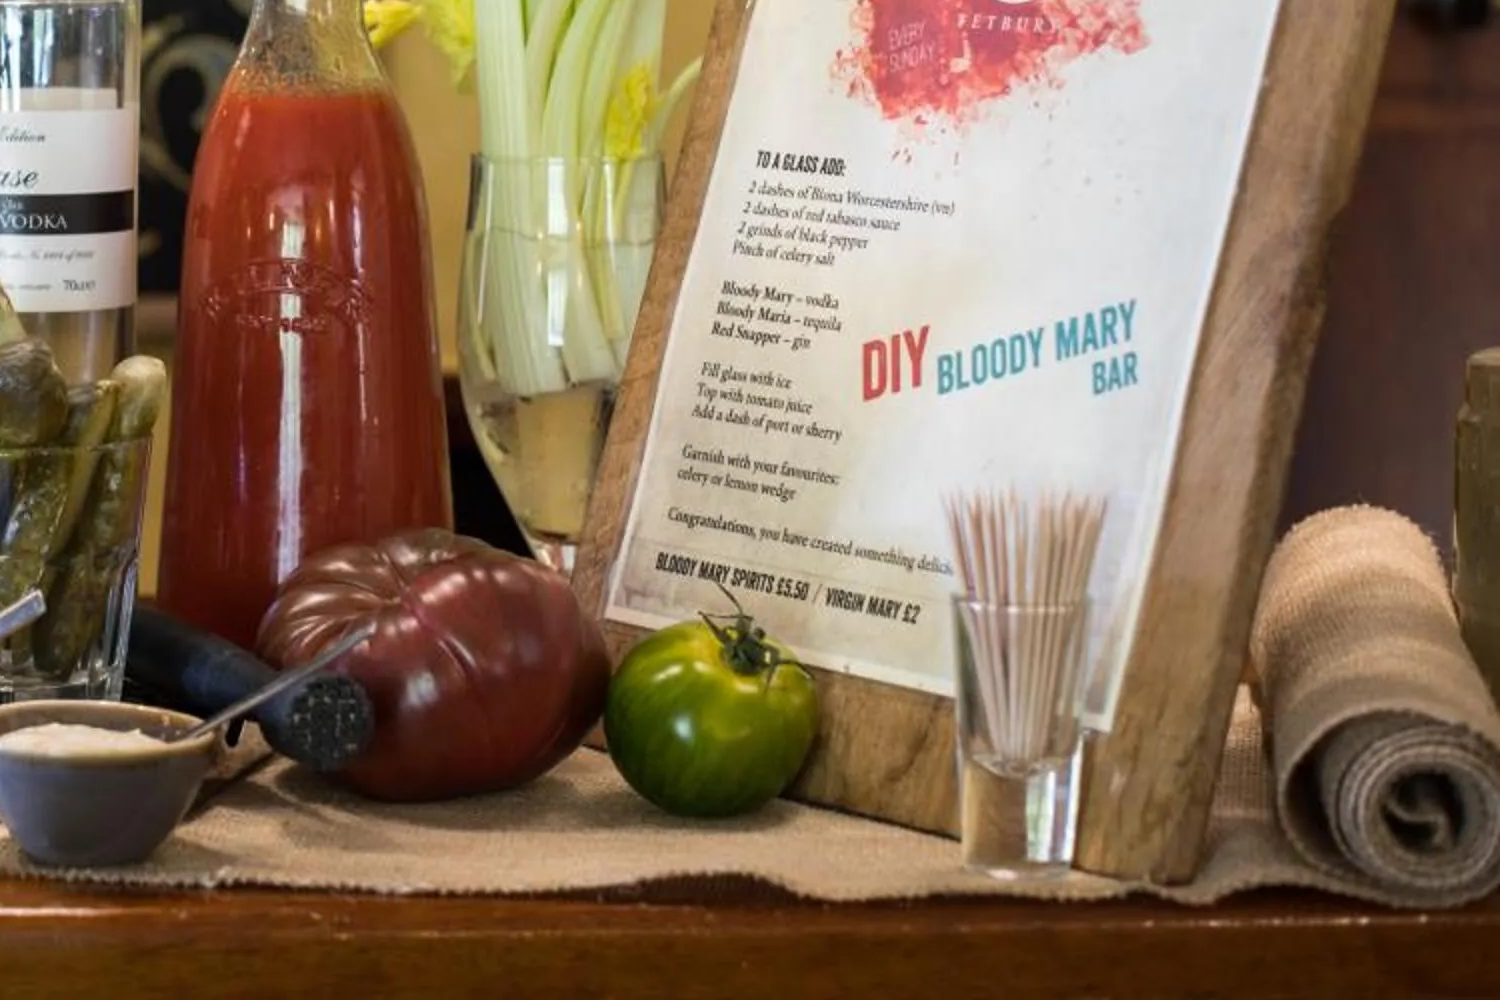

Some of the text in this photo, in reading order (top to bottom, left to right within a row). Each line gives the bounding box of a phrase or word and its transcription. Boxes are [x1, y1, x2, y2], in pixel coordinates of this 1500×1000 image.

[755, 150, 769, 168] TO
[771, 152, 780, 170] A
[781, 152, 819, 174] GLASS
[0, 211, 68, 230] VODKA
[721, 280, 760, 301] Bloody
[763, 286, 794, 308] Mary
[805, 293, 839, 309] vodka
[717, 300, 755, 322] Bloody
[757, 307, 791, 324] Maria
[803, 316, 842, 332] tequila
[711, 321, 735, 337] Red
[736, 324, 781, 347] Snapper
[791, 334, 811, 351] gin
[861, 298, 1138, 402] DIY BLOODY MARY
[701, 362, 793, 389] Fill glass with ice
[1092, 351, 1138, 395] BAR
[698, 382, 813, 415] Top with tomato juice
[692, 404, 715, 420] Add
[724, 409, 750, 426] dash
[751, 414, 767, 428] of
[765, 418, 789, 434] port
[791, 424, 803, 434] or
[805, 421, 842, 444] sherry
[682, 444, 725, 466] Garnish
[727, 452, 751, 470] with
[753, 459, 778, 476] your
[677, 467, 796, 503] celery or lemon wedge
[759, 527, 781, 543] you
[781, 528, 809, 548] have
[810, 534, 852, 556] created
[853, 544, 916, 571] something
[655, 550, 698, 578] BLOODY
[698, 560, 730, 585] MARY
[730, 567, 776, 594] SPIRITS
[775, 577, 810, 601] £5.50
[824, 587, 865, 611] VIRGIN
[865, 594, 901, 619] MARY
[900, 602, 921, 625] £2
